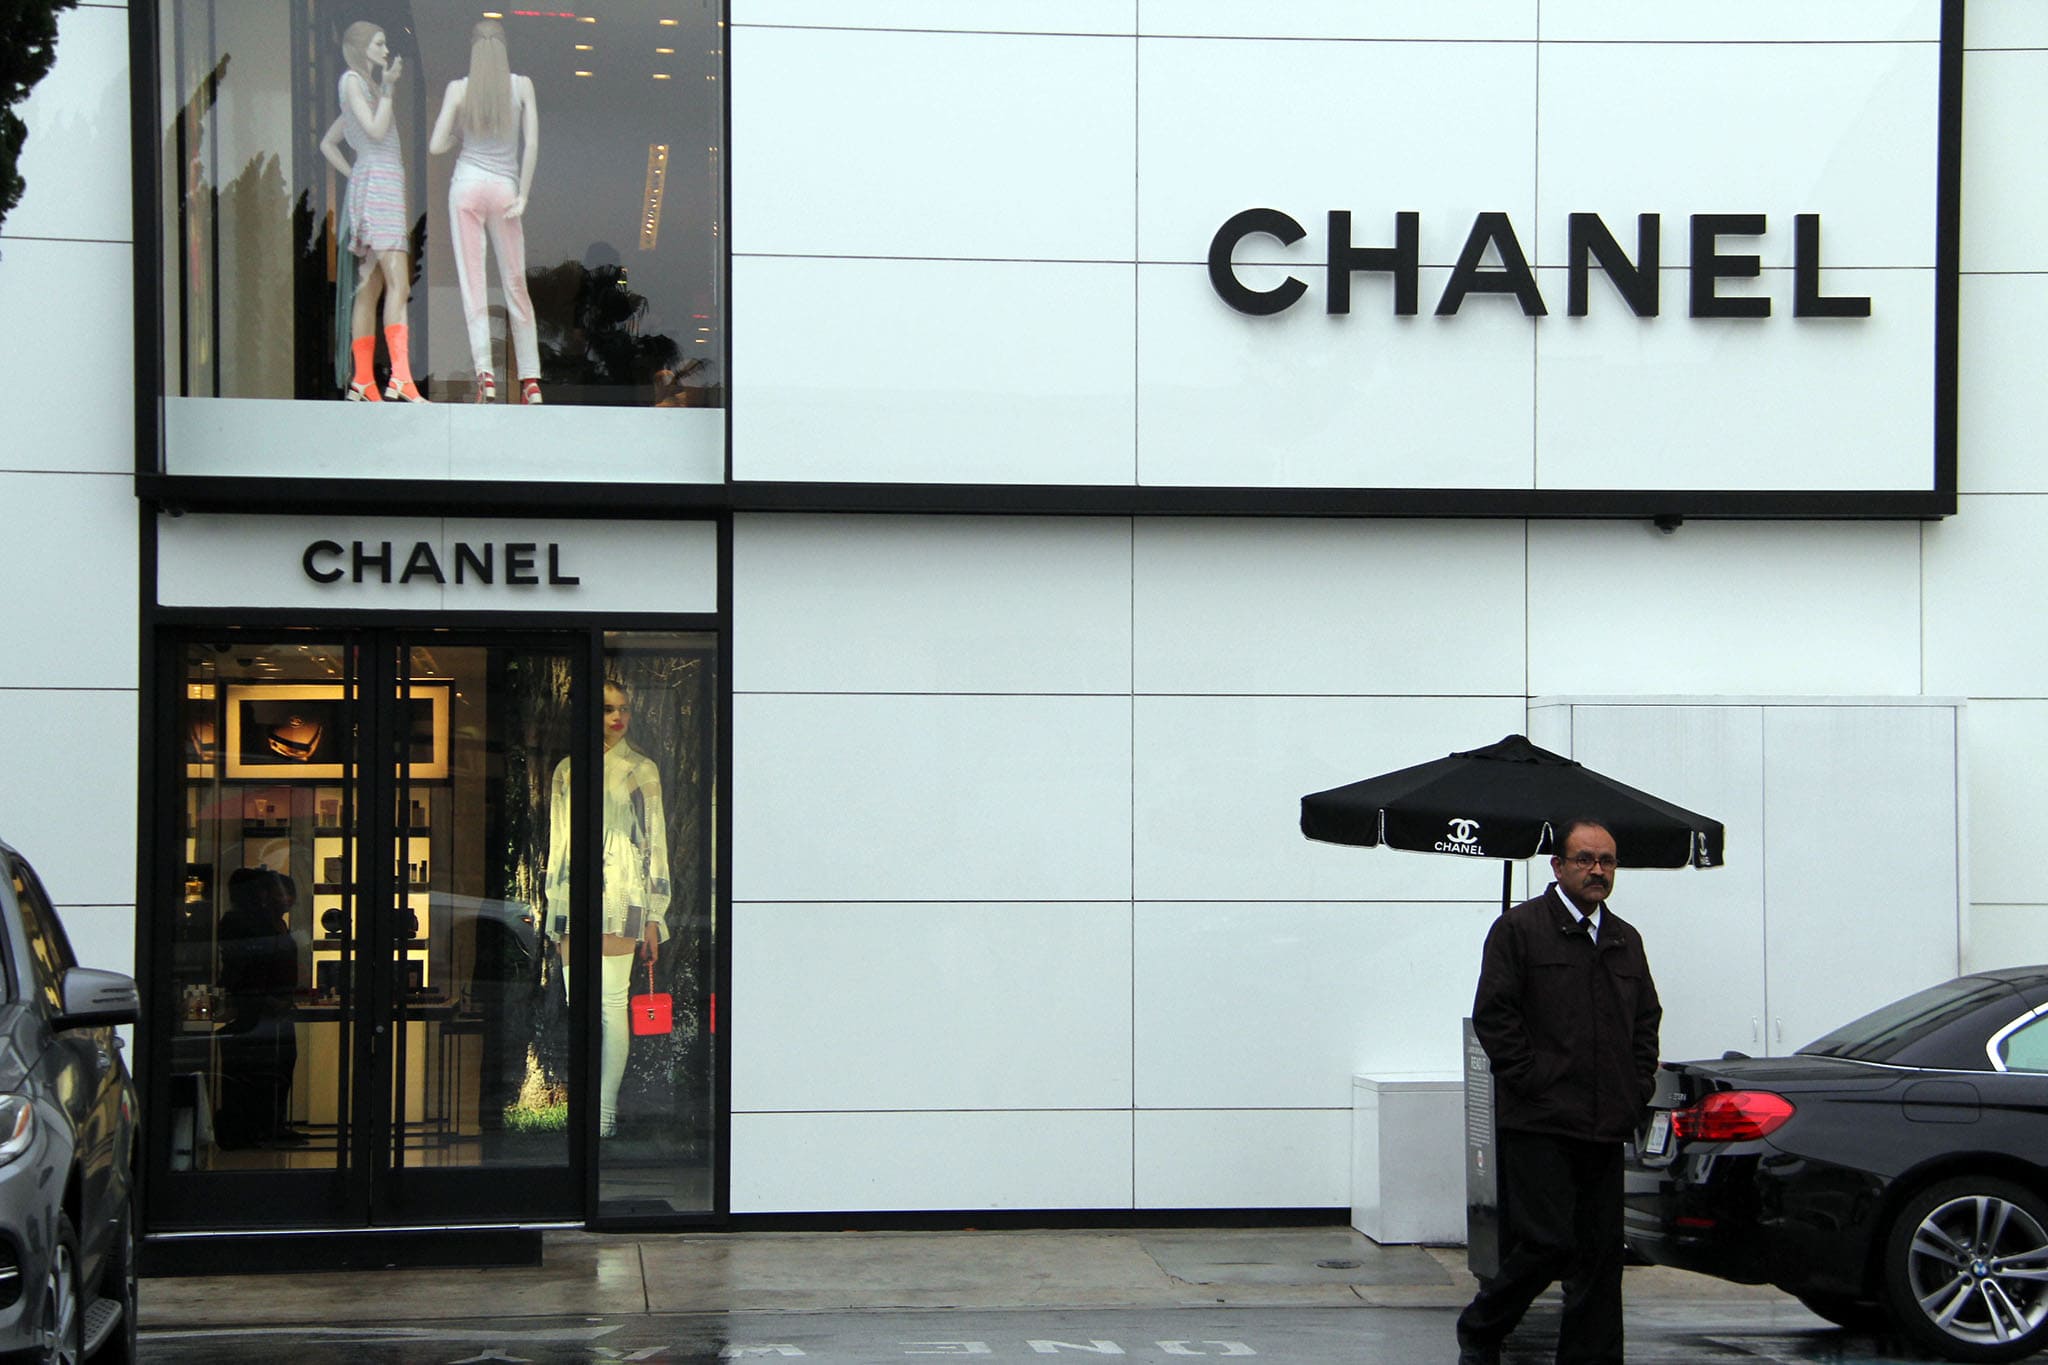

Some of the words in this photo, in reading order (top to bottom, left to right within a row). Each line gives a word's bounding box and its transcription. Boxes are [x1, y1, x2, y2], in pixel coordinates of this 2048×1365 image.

[1208, 207, 1871, 318] CHANEL
[302, 539, 580, 585] CHANEL
[1434, 841, 1485, 855] CHANEL
